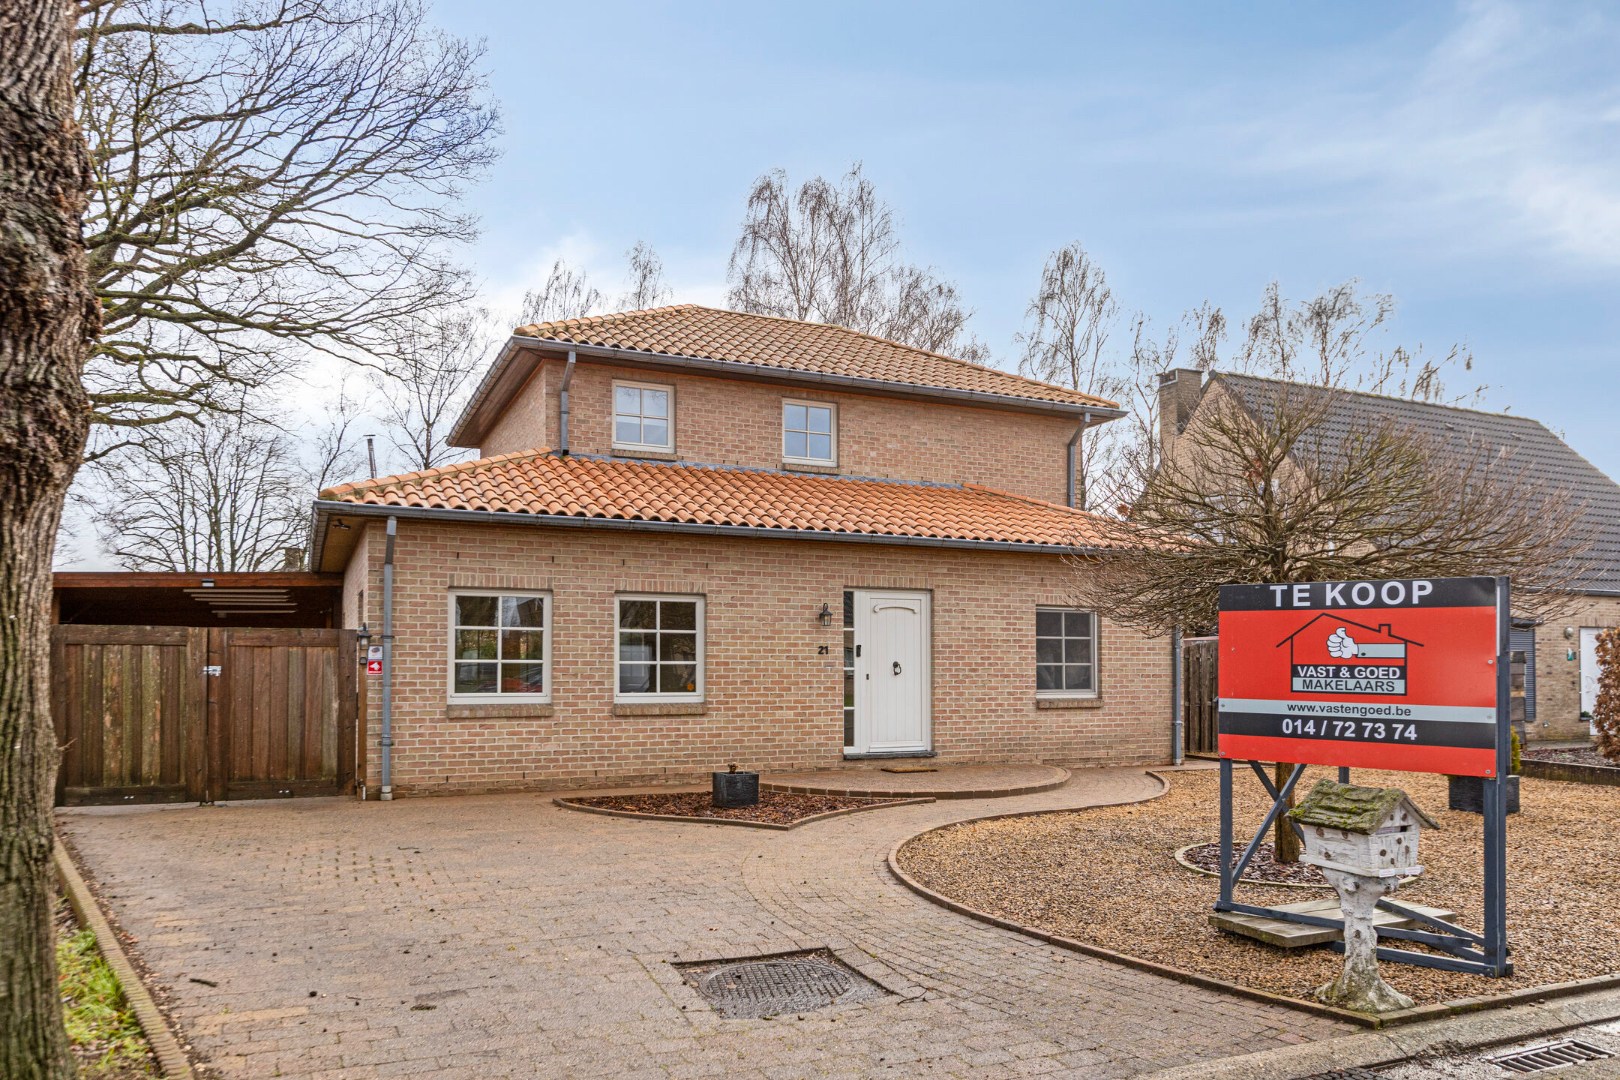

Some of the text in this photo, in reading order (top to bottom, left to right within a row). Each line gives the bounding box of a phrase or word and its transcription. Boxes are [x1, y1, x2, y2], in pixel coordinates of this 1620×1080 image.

[1269, 580, 1433, 608] TE KOOP
[817, 645, 829, 655] 21
[1297, 666, 1400, 679] VAST & GOED
[1302, 679, 1395, 693] MAKELAARS
[1287, 703, 1412, 717] www.vastengoed.be
[1282, 718, 1418, 741] 014 / 72 73 74
